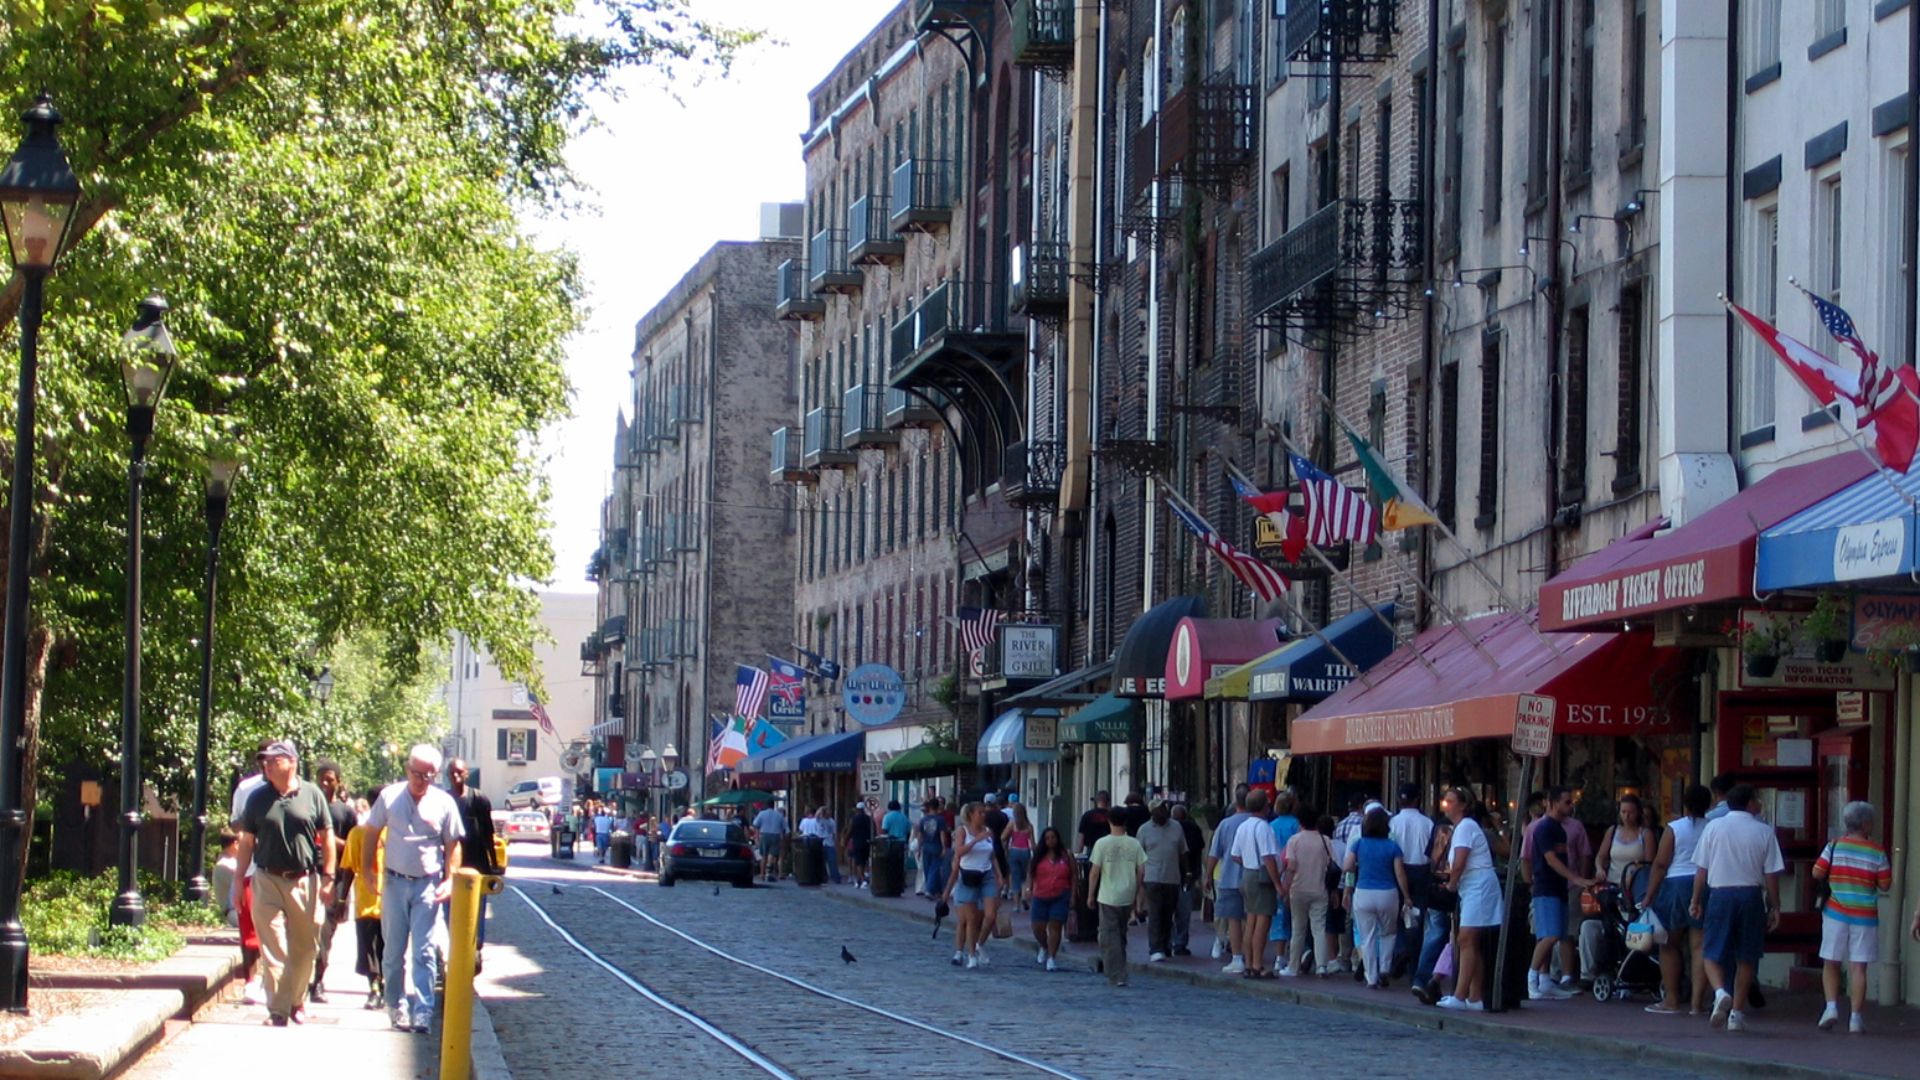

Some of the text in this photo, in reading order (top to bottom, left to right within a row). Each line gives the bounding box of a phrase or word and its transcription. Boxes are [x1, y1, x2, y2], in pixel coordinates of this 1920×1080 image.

[1562, 559, 1705, 621] RIVERBOAT TICKET OFFICE
[1021, 630, 1036, 638] THE
[1011, 639, 1046, 651] RIVER
[1011, 660, 1046, 672] GRILL
[1817, 665, 1853, 673] TICKET
[1784, 673, 1854, 684] INFORMATION
[772, 702, 802, 715] Grits
[1527, 700, 1543, 712] NO
[1517, 712, 1550, 727] PARKING
[1567, 703, 1671, 725] EST. 1973
[864, 780, 880, 792] 15
